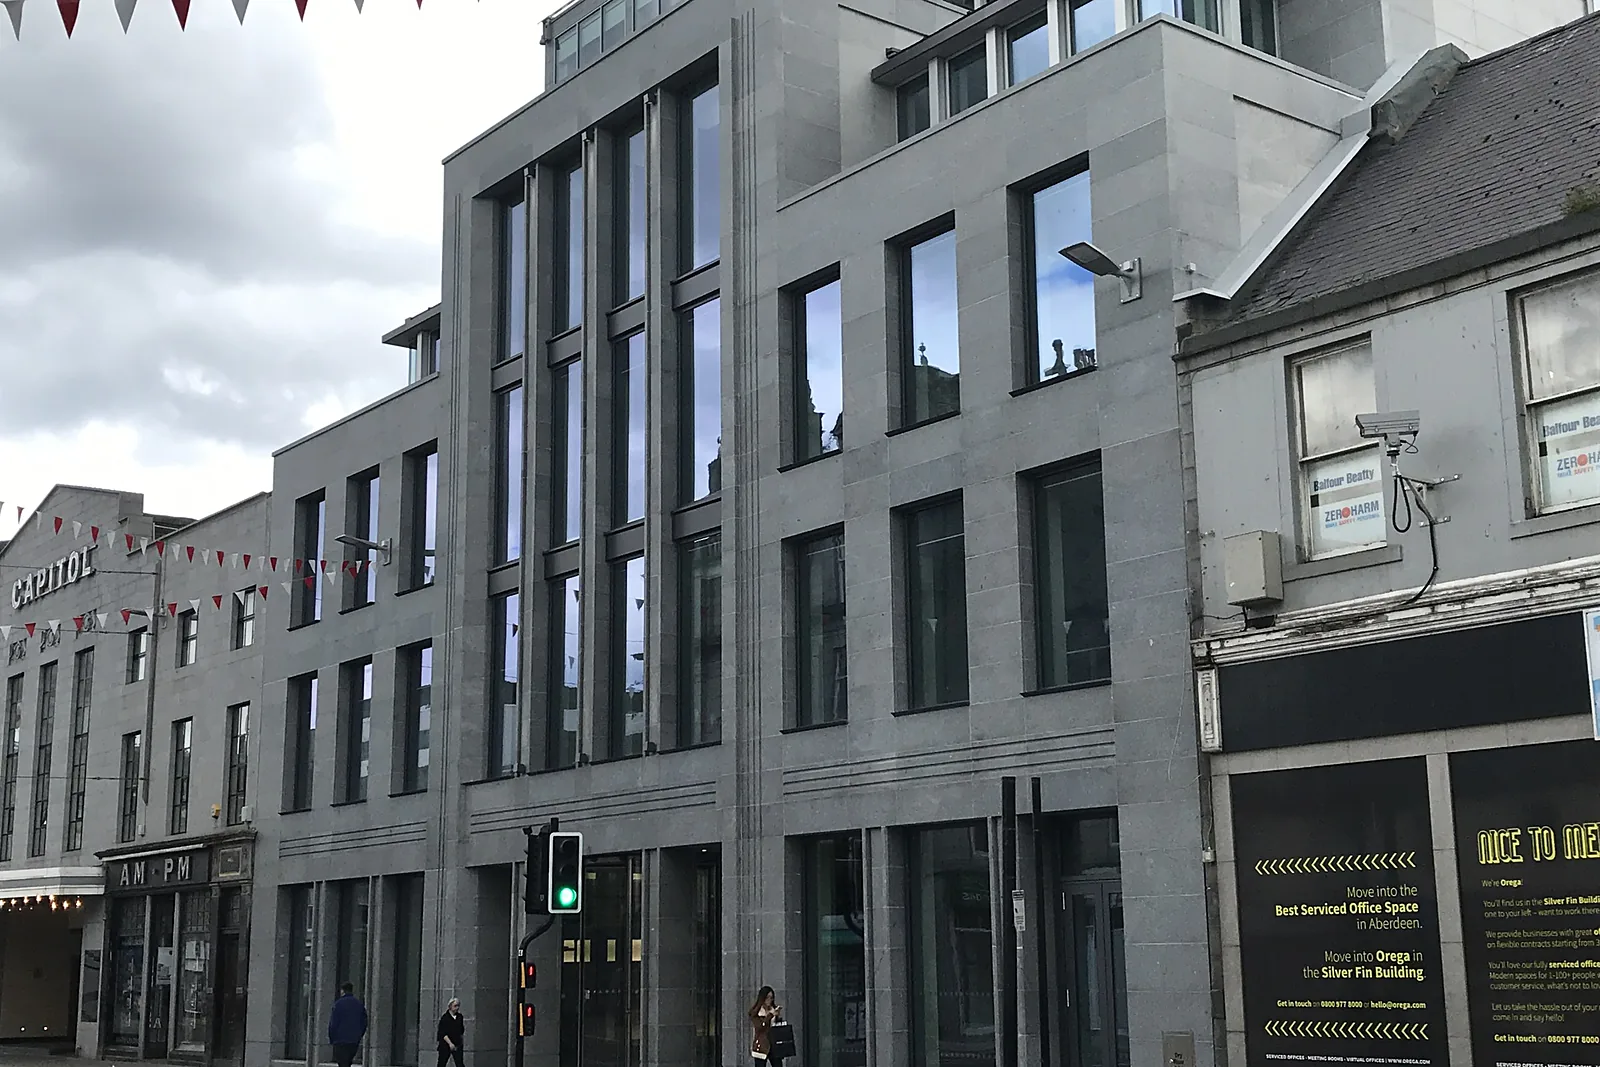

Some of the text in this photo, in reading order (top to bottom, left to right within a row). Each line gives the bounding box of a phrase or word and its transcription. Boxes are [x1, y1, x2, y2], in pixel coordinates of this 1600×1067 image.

[1543, 421, 1580, 437] Balfour
[1313, 469, 1374, 492] Balfour Beatty
[11, 546, 92, 609] CAPITOL
[1477, 827, 1523, 864] NICE
[1527, 825, 1556, 861] TO
[120, 856, 190, 886] AM PM
[1347, 884, 1418, 898] Move into the
[1532, 898, 1543, 906] the
[1543, 897, 1564, 905] Silver
[1565, 896, 1577, 904] Fin
[1275, 901, 1418, 916] Best Serviced Office Space
[1505, 910, 1520, 919] your
[1357, 917, 1423, 929] in Aberdeen.
[1485, 930, 1496, 938] We
[1575, 928, 1592, 938] great
[1578, 939, 1594, 947] from
[1324, 949, 1423, 964] Move into Orega in
[1549, 960, 1579, 968] serviced
[1303, 966, 1320, 978] the
[1321, 966, 1353, 978] Silver
[1355, 966, 1373, 978] Fin
[1572, 972, 1596, 980] people
[1370, 1001, 1426, 1010] hello@orega.com
[1494, 1034, 1507, 1042] Get
[1507, 1034, 1515, 1042] in
[1516, 1034, 1537, 1042] touch
[1547, 1035, 1565, 1043] 0800
[1566, 1035, 1580, 1043] 977
[1581, 1035, 1600, 1044] 8000
